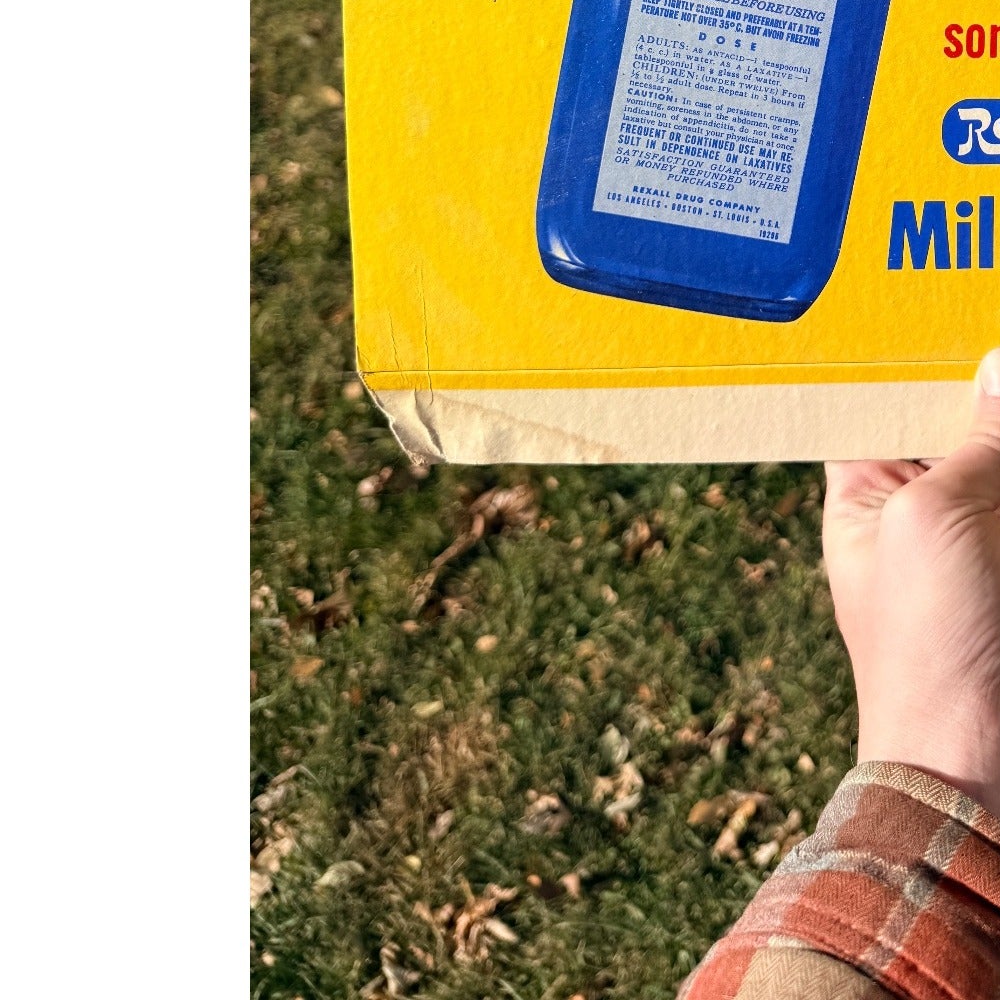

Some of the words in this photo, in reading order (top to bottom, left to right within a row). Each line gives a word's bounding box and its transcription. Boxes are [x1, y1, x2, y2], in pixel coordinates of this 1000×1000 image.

[640, 4, 679, 19] PERATURE
[680, 11, 697, 22] NOT
[697, 15, 717, 27] OVER
[745, 24, 761, 35] BUT
[762, 28, 784, 40] AVOID
[785, 32, 820, 47] FREEZING
[695, 3, 724, 17] CLOSED
[725, 9, 741, 20] AND
[742, 12, 787, 29] PREFERABLY
[786, 20, 798, 32] AT
[797, 23, 803, 33] A
[784, 5, 825, 21] USING
[634, 53, 693, 69] tablespoonful
[696, 63, 705, 72] in
[717, 67, 740, 79] glass
[742, 72, 752, 81] of
[755, 76, 781, 86] water.
[637, 34, 688, 50] ADULTS:
[691, 46, 704, 54] AS
[762, 59, 810, 74] teaspoonful
[672, 50, 681, 59] in
[719, 59, 731, 68] AS
[632, 60, 698, 80] CHILDREN:
[781, 88, 805, 100] From
[667, 76, 692, 88] adult
[717, 85, 747, 97] Repeat
[762, 93, 768, 102] 3
[770, 95, 794, 107] hours
[797, 100, 806, 109] if
[627, 87, 677, 102] CAUTION:
[681, 96, 692, 106] In
[694, 101, 711, 109] case
[714, 103, 724, 111] of
[726, 106, 766, 119] persistent
[622, 113, 655, 125] laxative
[657, 119, 671, 128] but
[672, 123, 704, 135] consult
[704, 129, 725, 139] your
[725, 132, 764, 145] physician
[764, 139, 775, 147] at
[623, 104, 666, 118] indication
[669, 113, 680, 121] of
[738, 125, 749, 133] do
[770, 131, 789, 141] take
[666, 105, 700, 115] soreness
[703, 110, 712, 118] in
[715, 112, 729, 121] the
[771, 123, 781, 131] or
[782, 125, 799, 136] any
[617, 134, 641, 146] SULT
[645, 138, 656, 149] IN
[661, 141, 720, 160] DEPENDENCE
[724, 152, 739, 164] ON
[743, 156, 792, 174] LAXATIVES
[619, 122, 666, 139] FREQUENT
[667, 130, 682, 143] OR
[684, 133, 735, 151] CONTINUED
[738, 143, 755, 155] USE
[758, 147, 777, 159] MAY
[614, 155, 630, 164] OR
[635, 158, 676, 172] MONEY
[680, 166, 742, 183] REFUNDED
[749, 178, 788, 192] WHERE
[616, 146, 704, 167] SATISFACTION
[710, 163, 790, 184] GUARANTEED
[666, 173, 734, 191] PURCHASED
[606, 191, 622, 202] LOS
[625, 195, 661, 208] ANGELES
[671, 202, 702, 215] BOSTON
[726, 212, 749, 223] LOUIS
[632, 185, 670, 197] REXALL
[675, 192, 703, 203] DRUG
[708, 198, 760, 213] COMPANY
